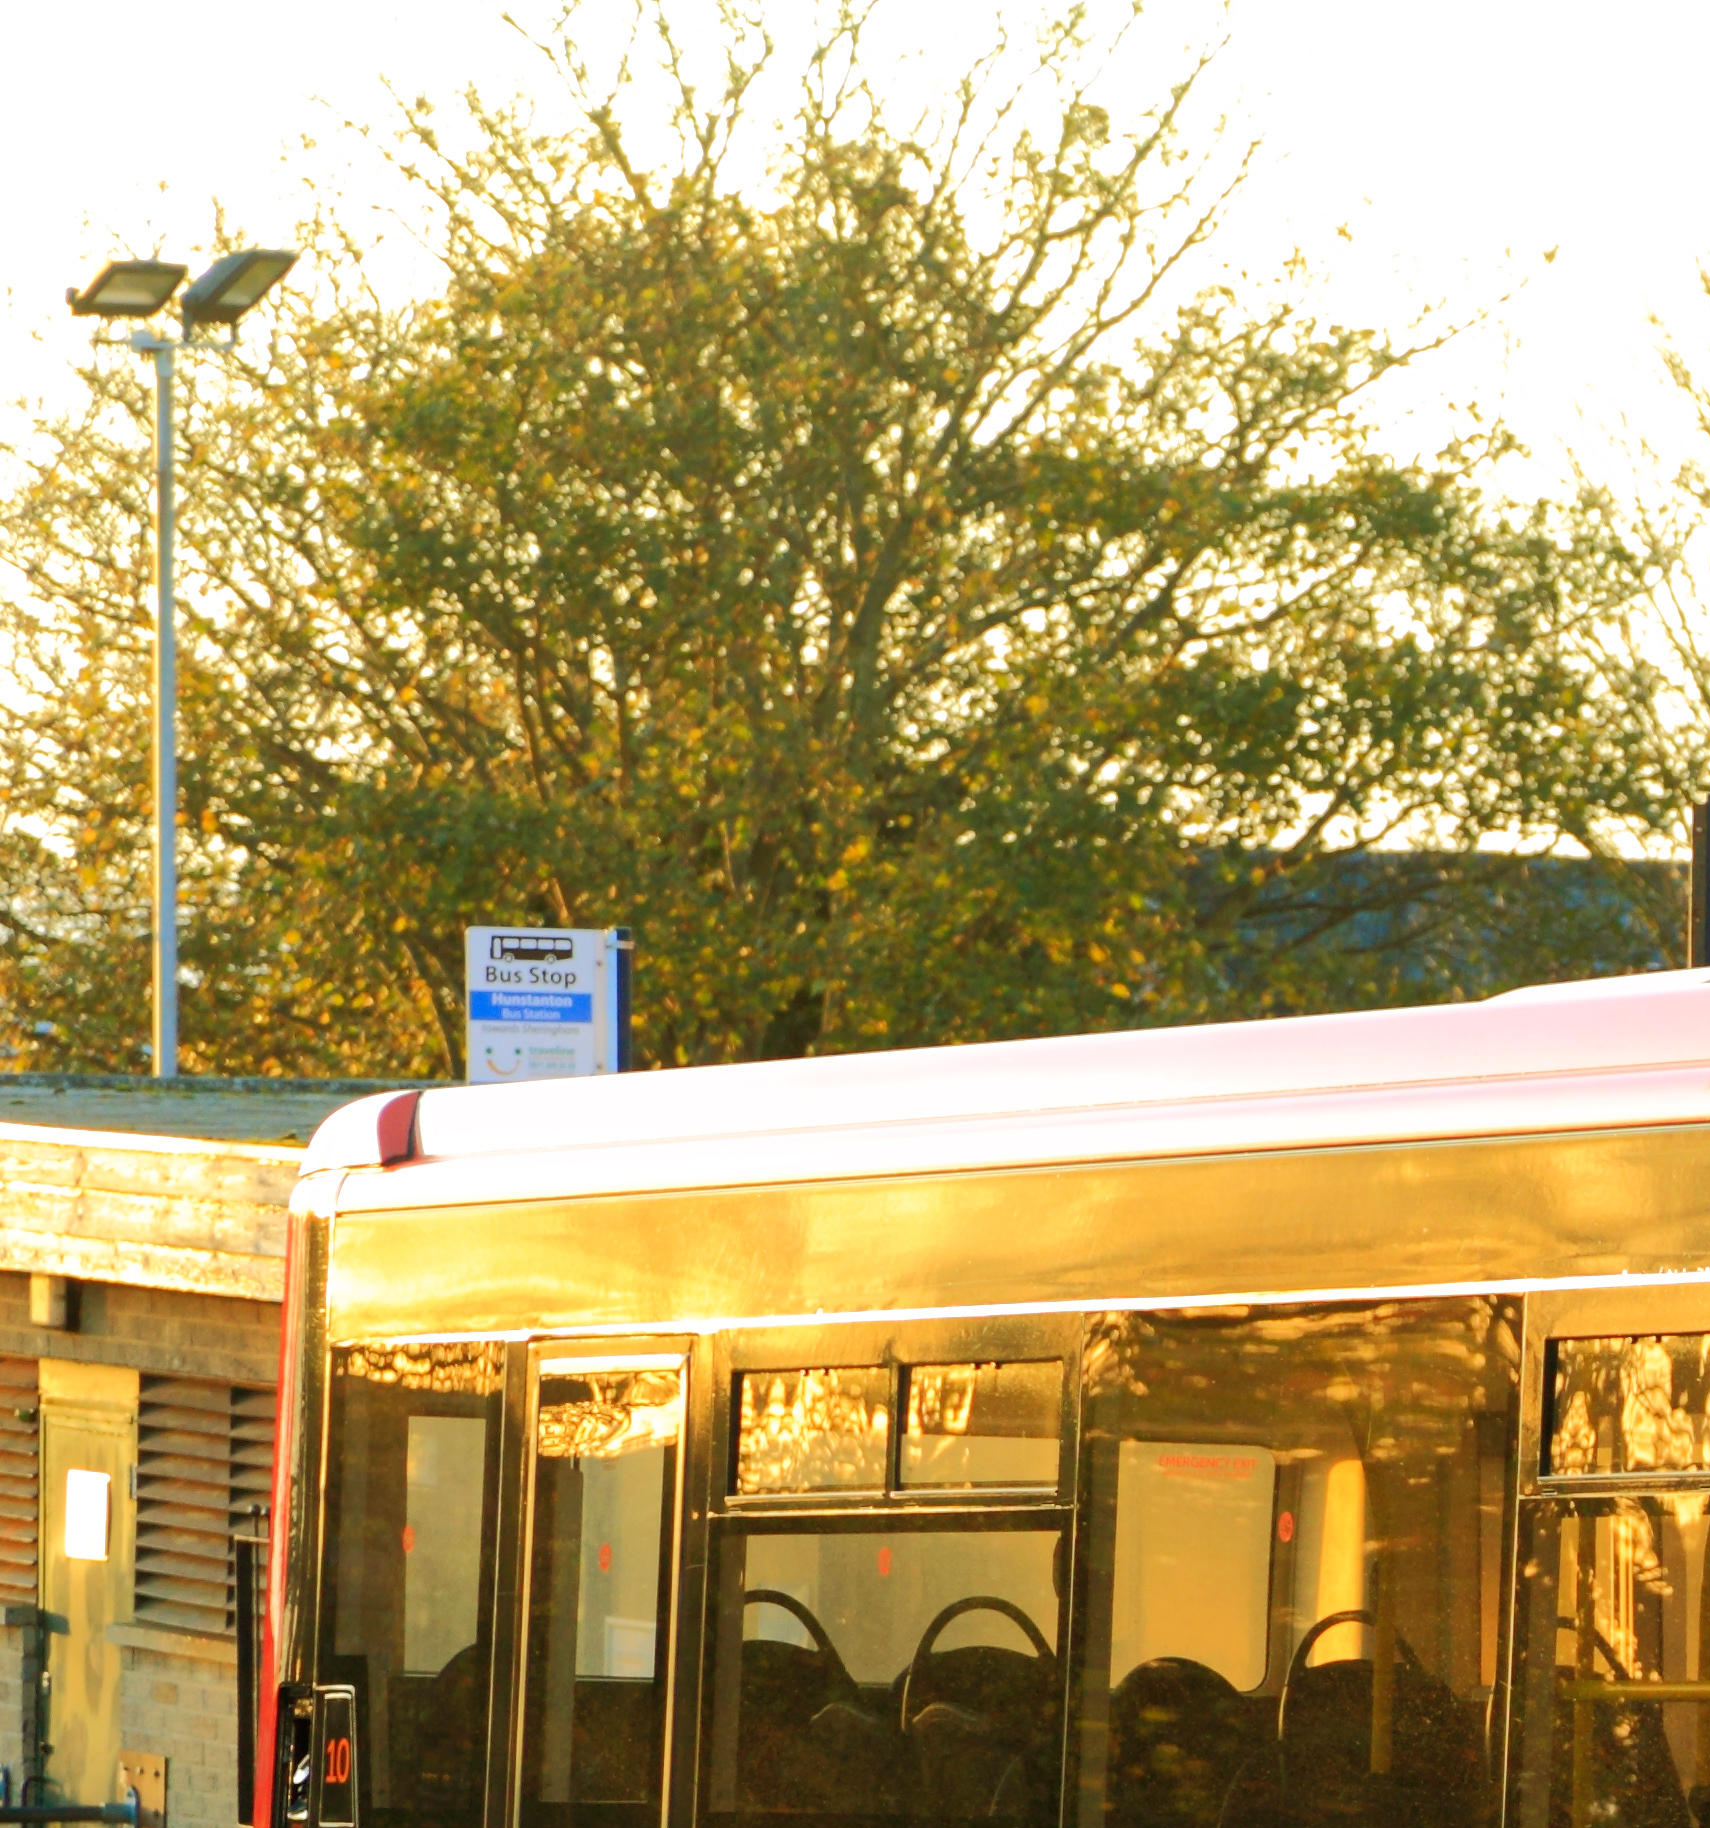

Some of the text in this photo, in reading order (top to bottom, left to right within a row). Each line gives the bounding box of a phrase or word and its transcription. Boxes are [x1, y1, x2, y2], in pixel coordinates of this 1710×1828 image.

[486, 966, 577, 989] Bus Stop
[491, 992, 573, 1007] Hunstanton
[502, 1008, 561, 1021] Bus Station
[325, 1737, 350, 1784] 10
